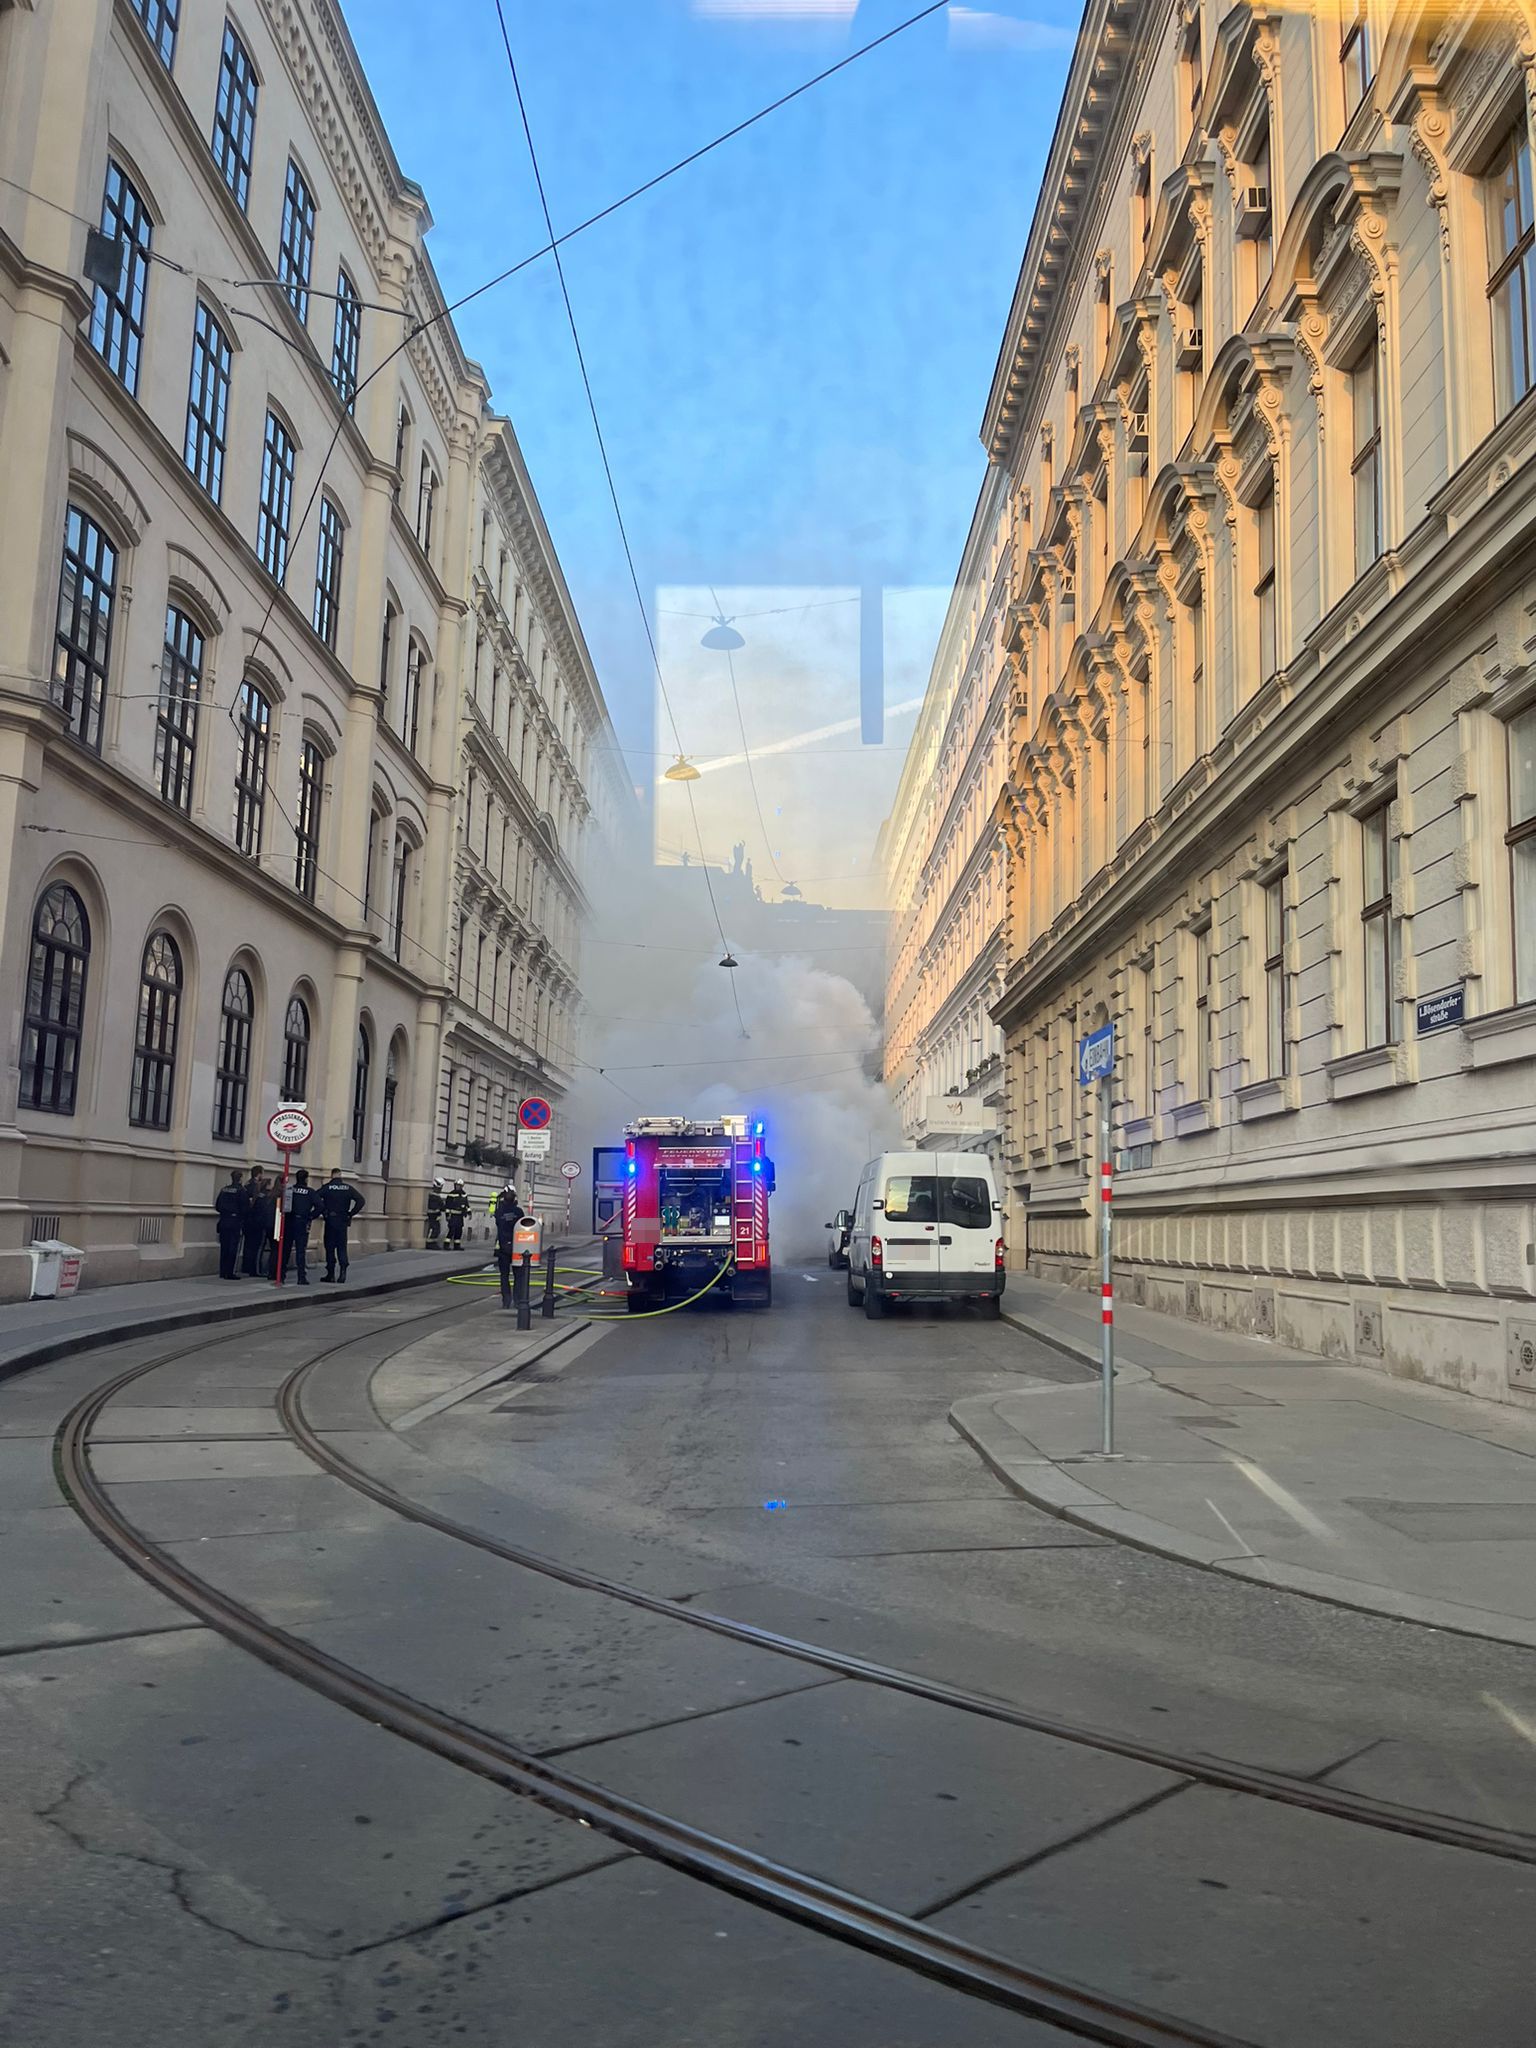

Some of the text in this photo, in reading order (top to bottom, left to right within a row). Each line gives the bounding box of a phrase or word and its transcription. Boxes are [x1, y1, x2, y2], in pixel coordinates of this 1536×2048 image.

[1430, 1009, 1449, 1024] straße
[273, 1113, 308, 1127] STRASSENBAHN
[274, 1130, 306, 1142] HALTESTELLE
[524, 1152, 542, 1160] Anfang
[739, 1226, 750, 1235] 21
